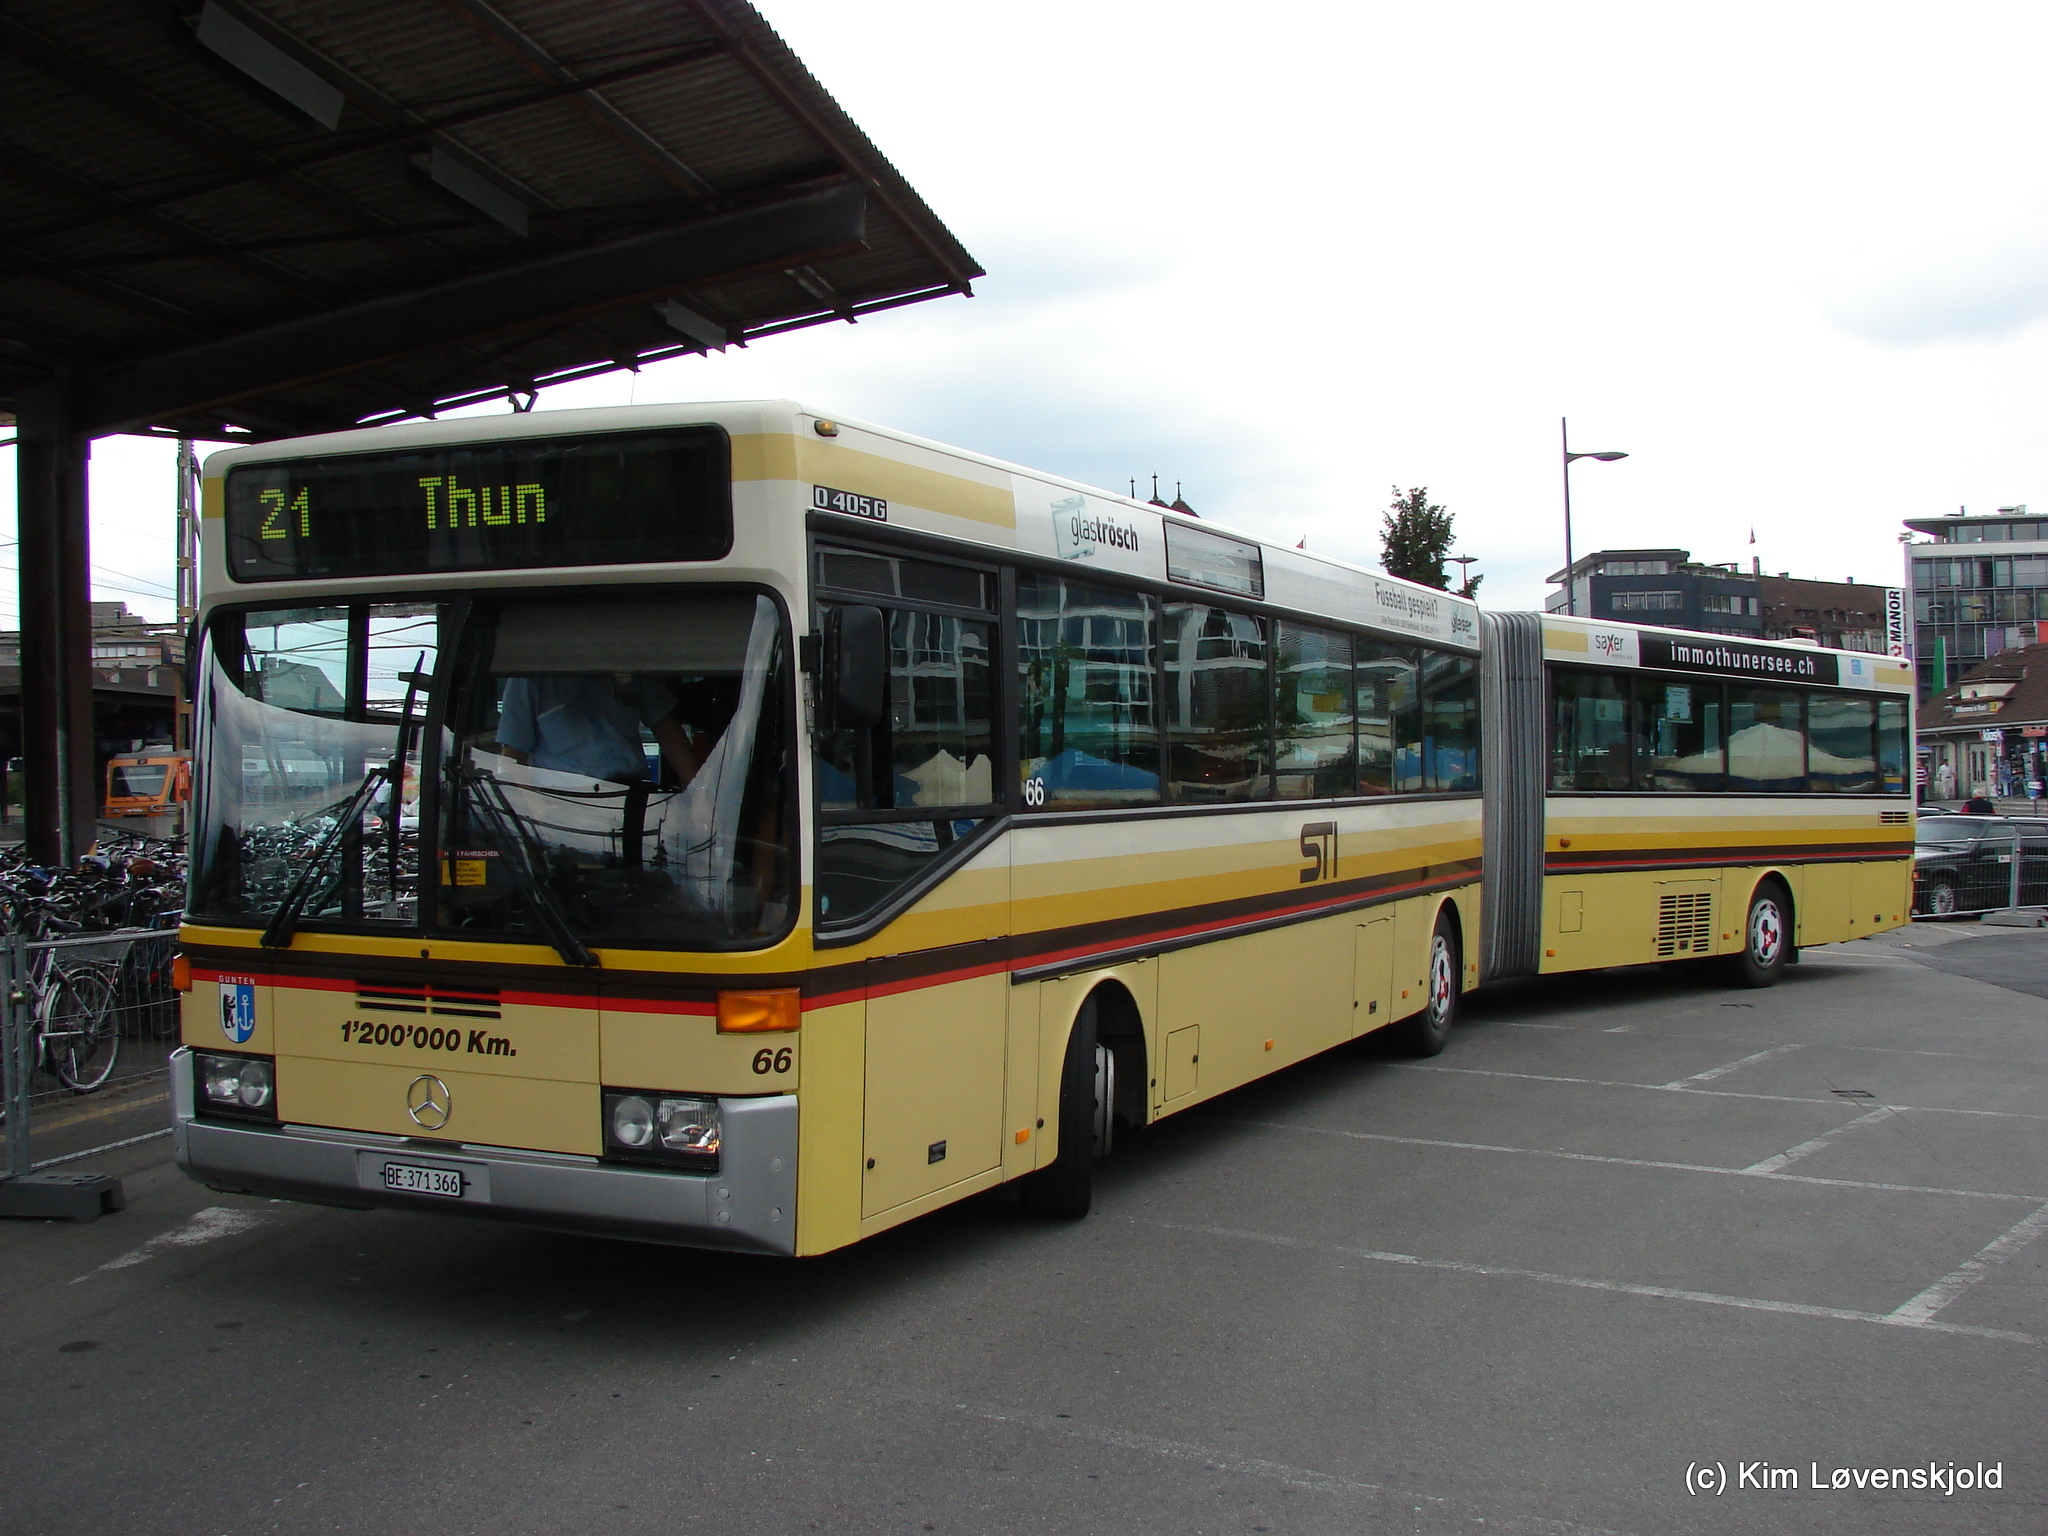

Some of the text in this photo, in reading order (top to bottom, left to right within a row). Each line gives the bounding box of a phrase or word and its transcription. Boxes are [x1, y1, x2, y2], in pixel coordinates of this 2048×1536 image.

[260, 475, 545, 540] 21 Thun
[1071, 510, 1138, 552] glaströsch
[1375, 582, 1407, 612] Fussball
[1889, 590, 1902, 642] MANOR
[1670, 640, 1814, 675] immothunersee.ch
[1025, 776, 1044, 806] 66
[1300, 821, 1337, 883] STI
[218, 975, 256, 986] GUNTEN
[341, 1020, 517, 1056] 1'200'000 Km.
[752, 1047, 793, 1074] 66
